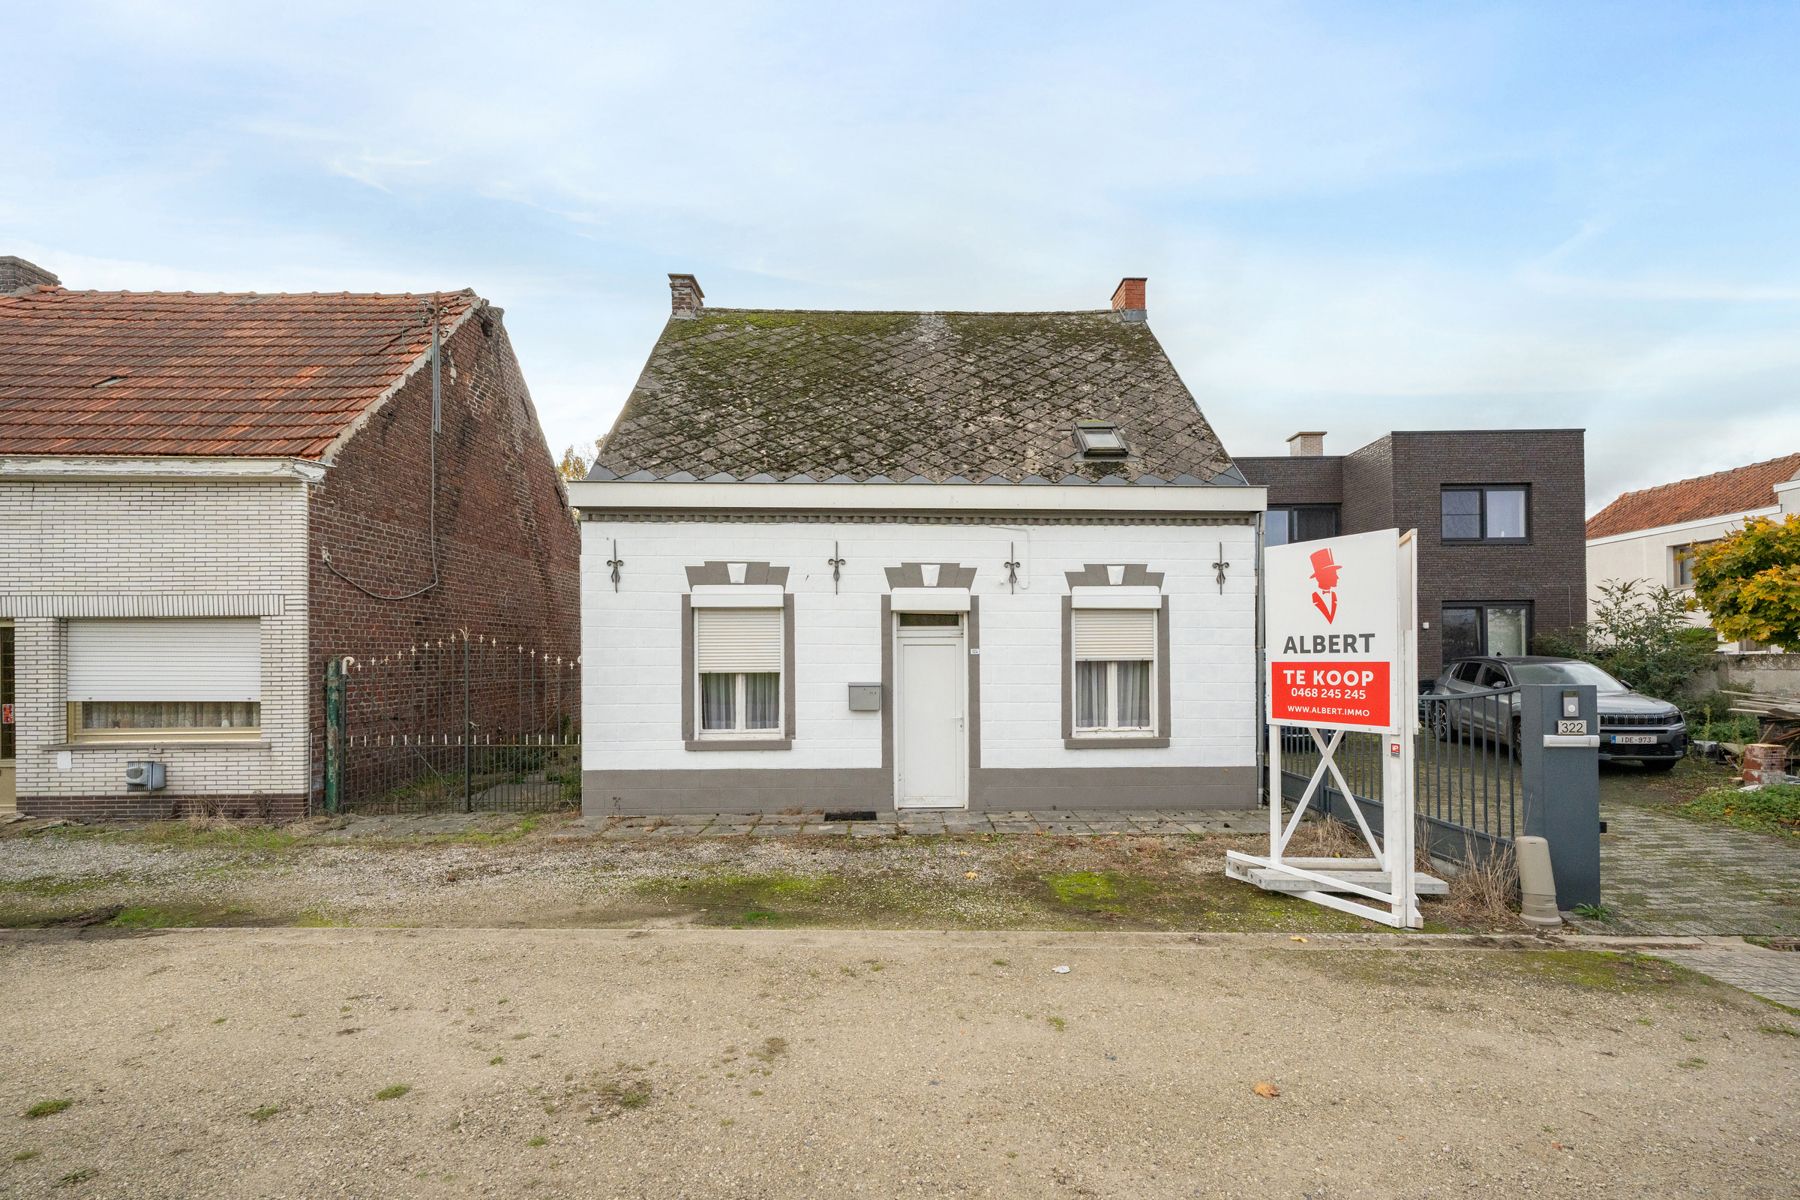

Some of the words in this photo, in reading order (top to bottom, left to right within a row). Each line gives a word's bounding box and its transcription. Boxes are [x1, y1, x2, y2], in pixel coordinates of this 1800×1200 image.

[1283, 633, 1375, 654] ALBERT
[1283, 670, 1306, 685] TE
[1313, 670, 1374, 686] KOOP
[1291, 688, 1318, 697] 0468
[1321, 688, 1341, 698] 245
[1344, 689, 1366, 699] 245
[1287, 705, 1370, 717] WWW.ALBERT.IMMO
[1561, 722, 1584, 733] 322
